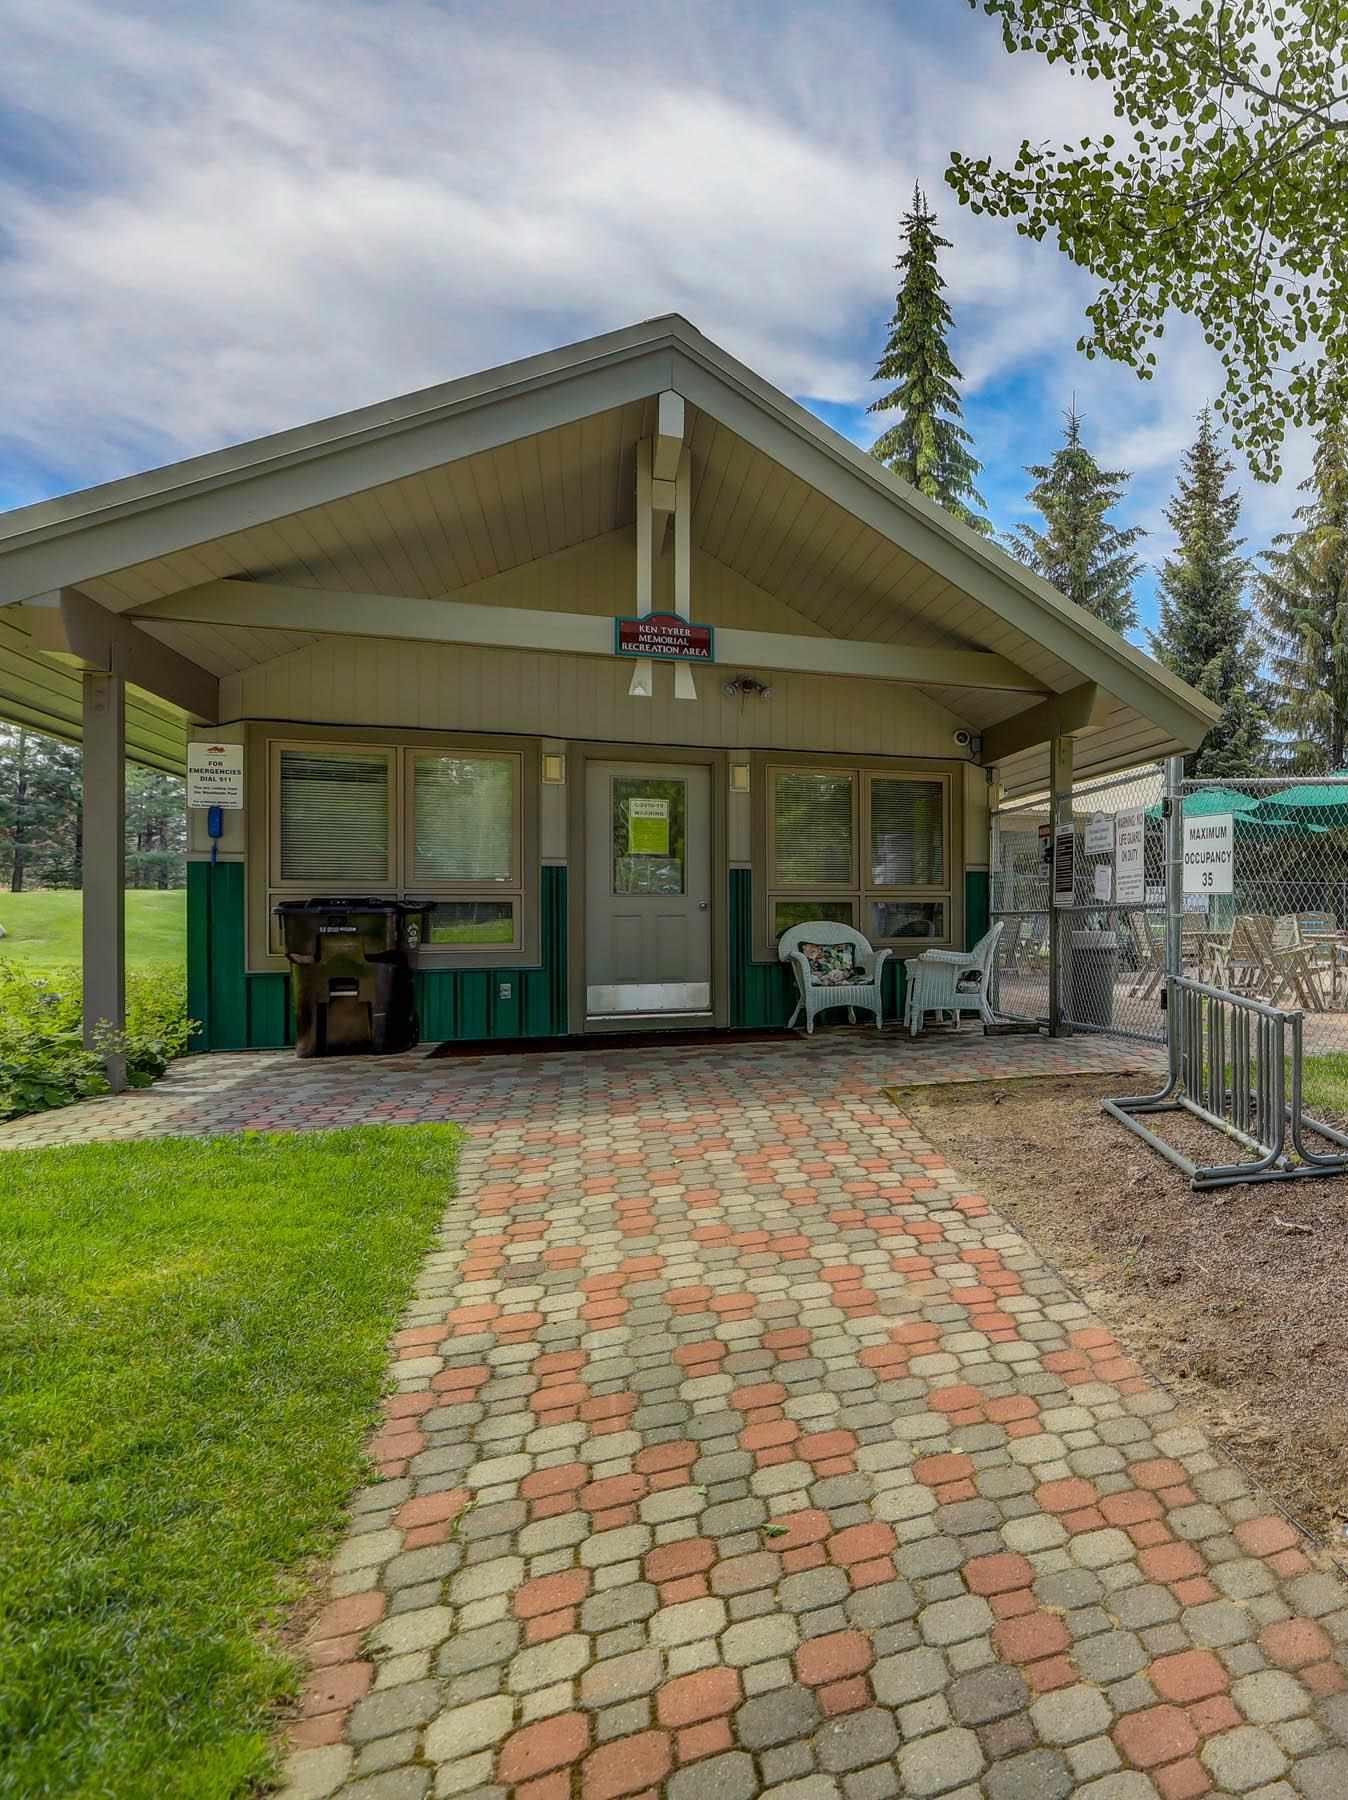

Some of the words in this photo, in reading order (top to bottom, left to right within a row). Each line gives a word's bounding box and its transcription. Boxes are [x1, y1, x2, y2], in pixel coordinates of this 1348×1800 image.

[639, 624, 658, 633] KEN
[661, 626, 691, 637] TYRER
[638, 635, 689, 646] MEMORIAL
[622, 642, 679, 654] RECREATION
[682, 647, 708, 657] AREA
[1189, 825, 1227, 841] MAXIMUM
[1184, 849, 1232, 865] OCCUPANCY
[1201, 872, 1214, 887] 35
